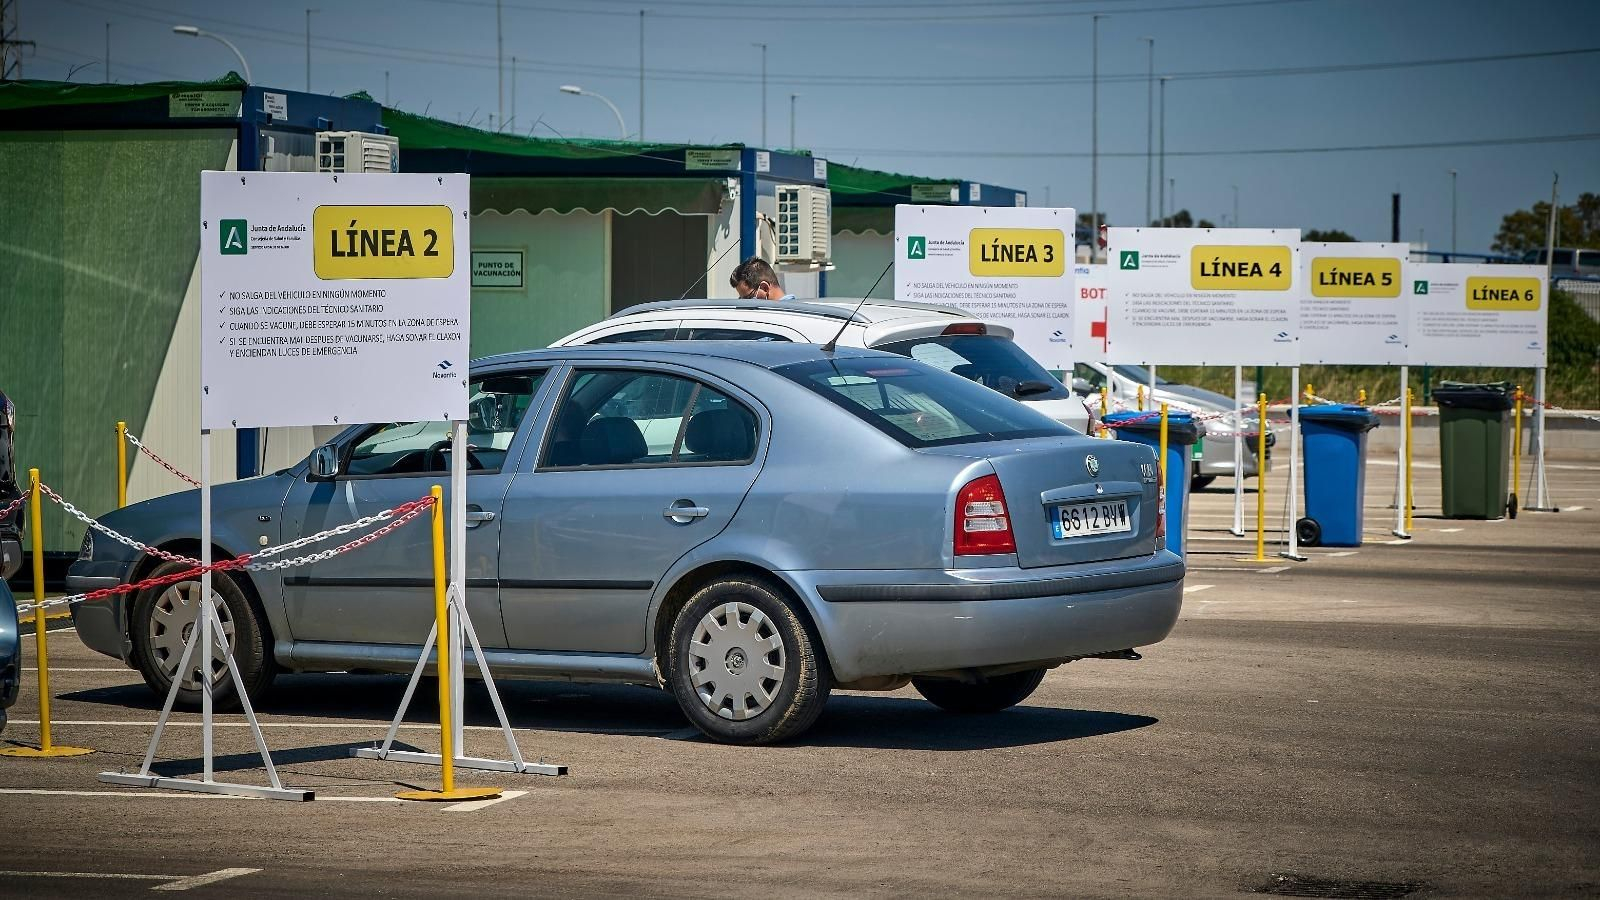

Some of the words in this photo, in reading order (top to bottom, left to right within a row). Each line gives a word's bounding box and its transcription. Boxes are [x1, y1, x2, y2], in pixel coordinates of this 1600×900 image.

[251, 224, 267, 232] Junta
[269, 224, 277, 232] de
[277, 223, 306, 232] Andalucía
[331, 220, 415, 258] LÍNEA
[423, 229, 439, 257] 2
[981, 238, 1038, 263] LÍNEA
[1043, 244, 1054, 263] 3
[1200, 257, 1263, 277] LÍNEA
[1269, 262, 1282, 277] 4
[473, 269, 521, 277] VACUNACIÓN
[1320, 267, 1376, 286] LÍNEA
[1381, 272, 1392, 286] 5
[229, 291, 240, 300] NO
[241, 291, 262, 299] SALGA
[264, 291, 276, 299] DEL
[312, 290, 321, 299] EN
[350, 290, 386, 298] MOMENTO
[1473, 285, 1520, 301] LÍNEA
[1524, 289, 1534, 301] 6
[229, 307, 245, 315] SIGA
[246, 307, 258, 315] LAS
[260, 306, 306, 314] INDICACIONES
[307, 306, 319, 314] DEL
[350, 305, 384, 313] SANITARIO
[229, 322, 259, 330] CUANDO
[299, 321, 316, 329] DEBE
[347, 320, 355, 328] 15
[356, 320, 387, 328] MINUTOS
[388, 319, 396, 327] EN
[398, 319, 406, 327] LA
[407, 319, 425, 327] ZONA
[426, 319, 435, 327] DE
[248, 337, 289, 345] ENCUENTRA
[386, 334, 404, 342] HAGA
[405, 334, 427, 342] SONAR
[229, 349, 234, 357] Y
[235, 349, 276, 357] ENCIENDAN
[278, 348, 299, 356] LUCES
[301, 348, 310, 356] DE
[312, 347, 357, 355] EMERGENCIA
[1061, 506, 1100, 531] 6612
